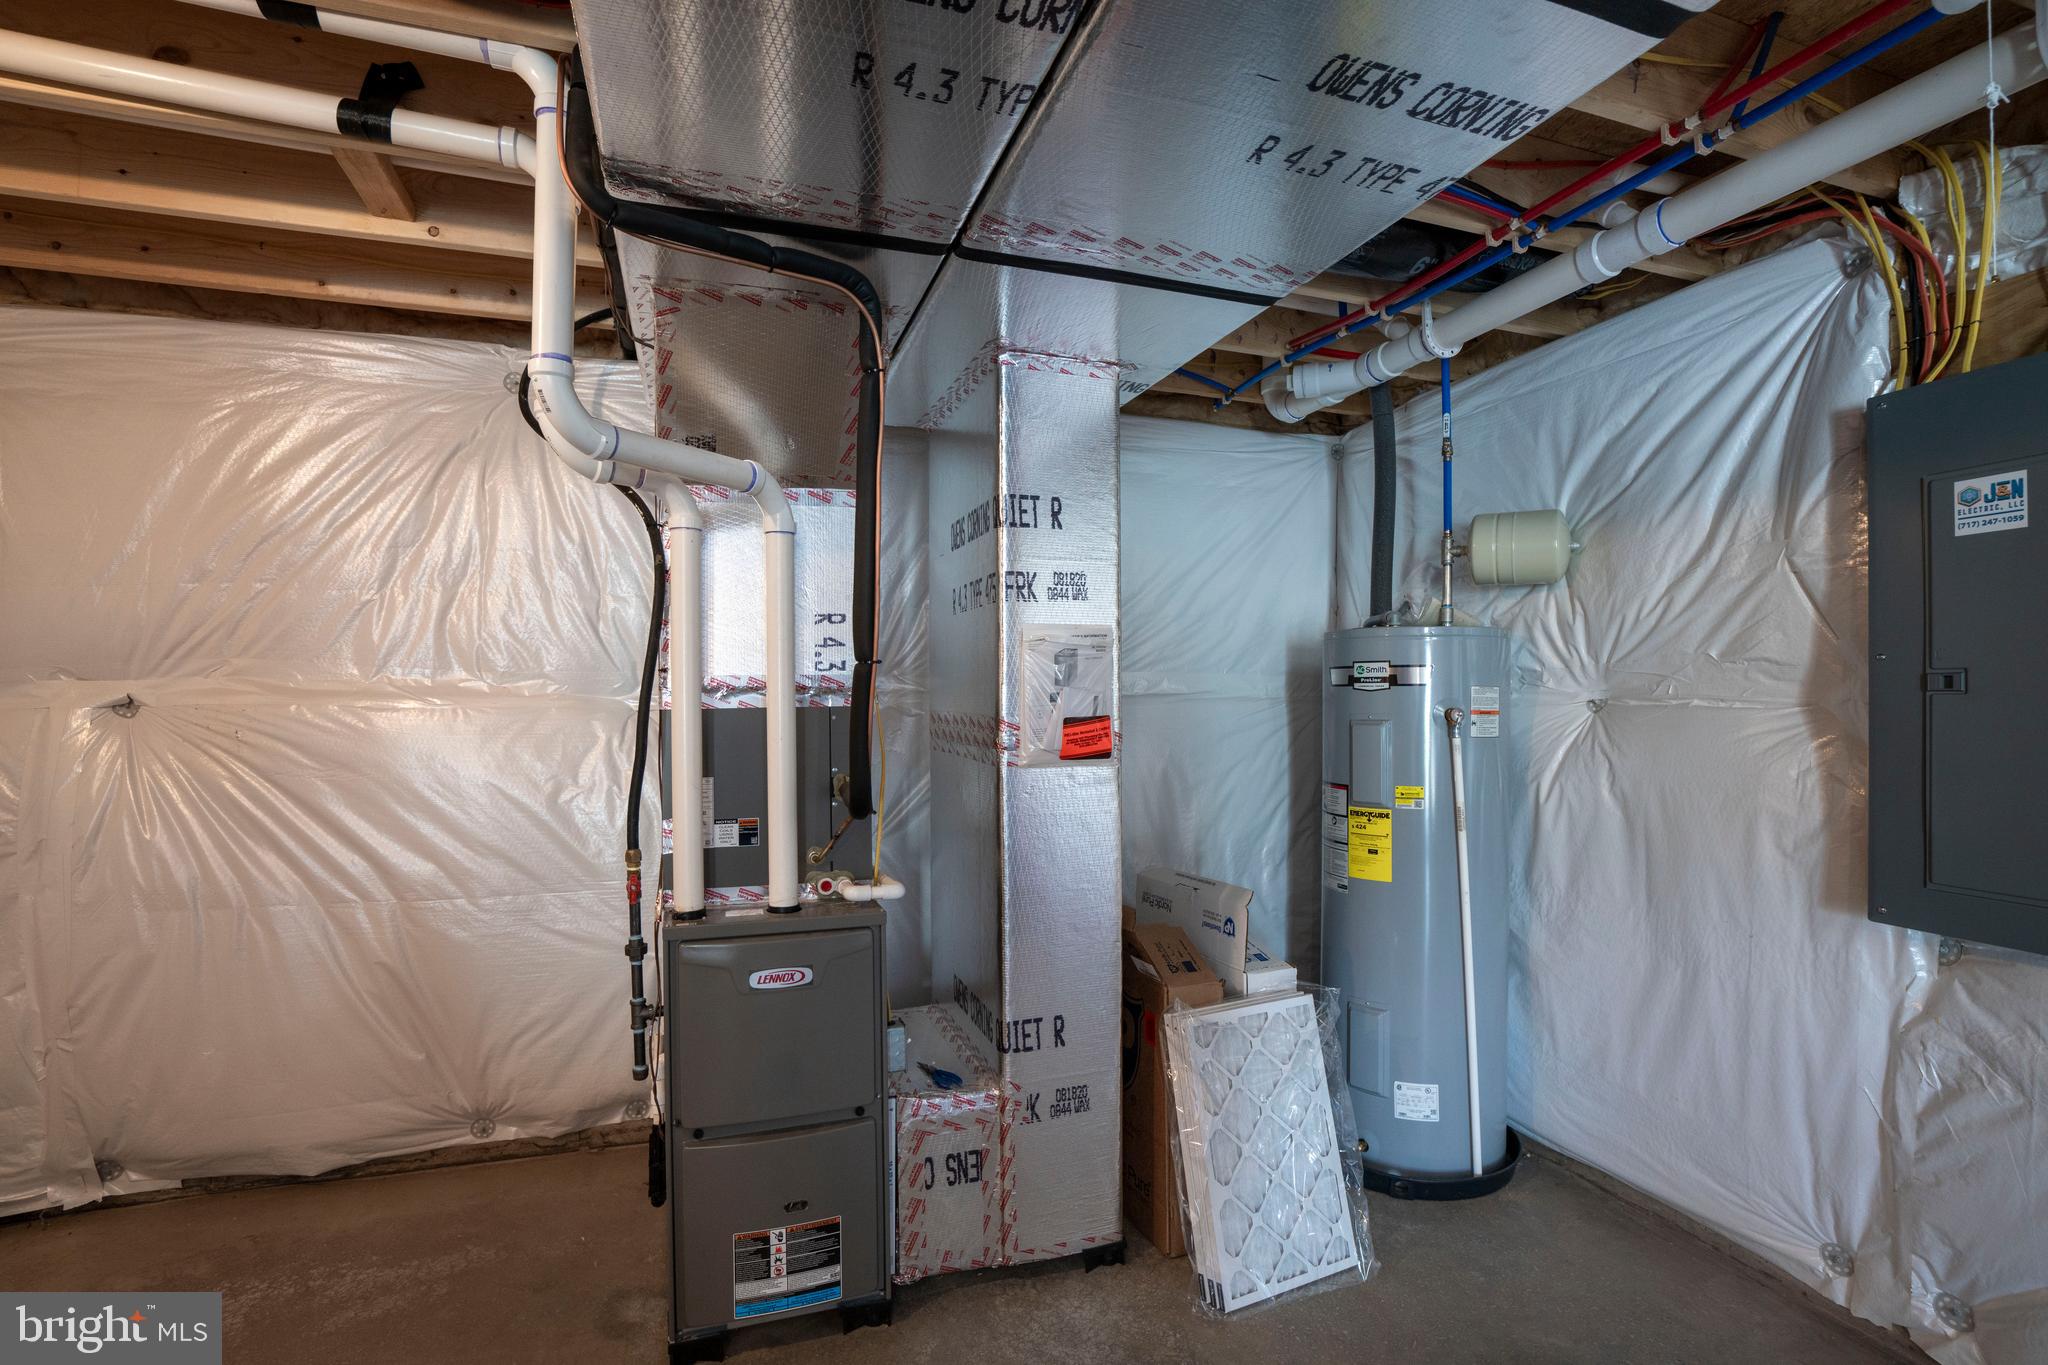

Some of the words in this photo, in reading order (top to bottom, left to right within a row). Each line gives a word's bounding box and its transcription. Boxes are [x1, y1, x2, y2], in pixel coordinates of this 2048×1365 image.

[851, 51, 875, 89] R
[894, 62, 960, 104] 4.3
[1306, 54, 1422, 109] OWENS
[1406, 82, 1550, 141] CORNING
[1246, 135, 1280, 164] R
[1284, 144, 1346, 178] 4.3
[1342, 156, 1421, 194] TYPE
[1051, 496, 1063, 530] R
[2008, 500, 2025, 508] LLC
[1957, 520, 1980, 530] (717)
[1981, 514, 2025, 526] 247-1059
[1005, 571, 1039, 602] FRK
[814, 612, 847, 626] R
[814, 636, 847, 672] 4.3
[1366, 665, 1387, 674] Smith
[757, 972, 796, 985] LENNOX
[996, 1014, 1043, 1054] QUIET
[1053, 1014, 1066, 1048] R
[946, 1149, 982, 1187] ENS
